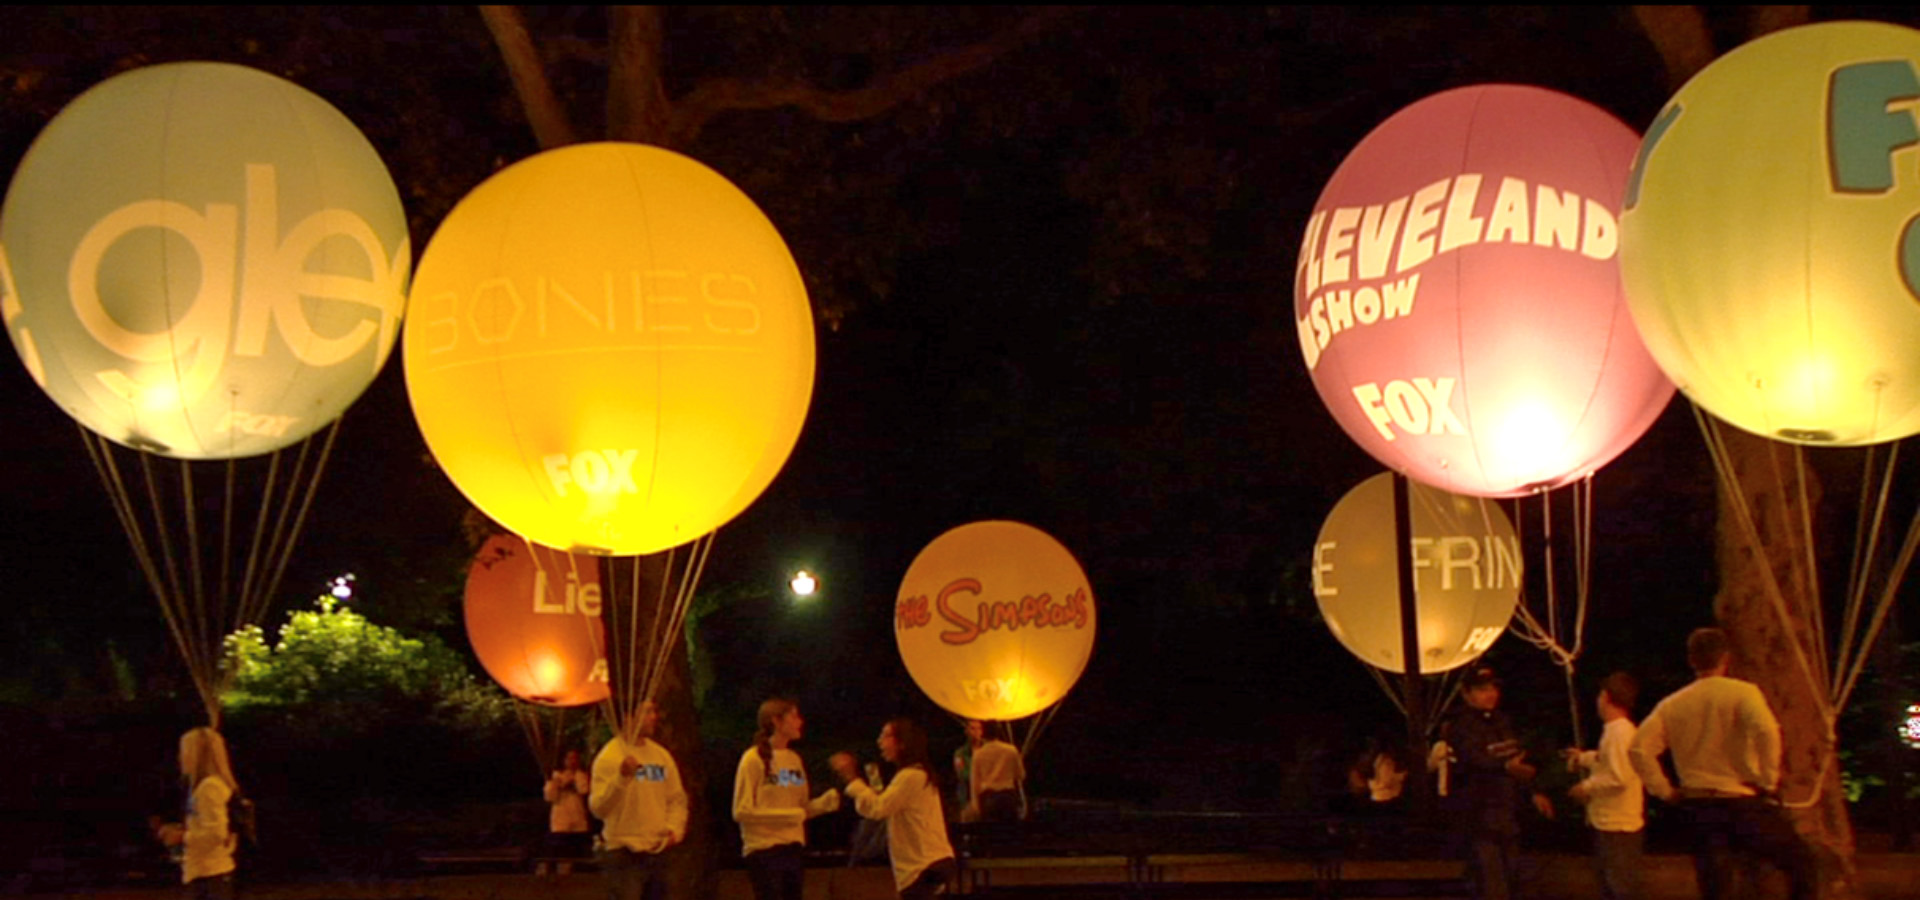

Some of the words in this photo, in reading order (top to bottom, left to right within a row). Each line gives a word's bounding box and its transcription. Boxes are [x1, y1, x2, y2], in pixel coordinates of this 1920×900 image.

[420, 269, 760, 356] BONES
[1311, 273, 1420, 350] SHOW
[213, 410, 301, 438] FOX
[1352, 377, 1466, 441] FOX
[543, 448, 640, 498] FOX
[533, 570, 602, 617] Lie
[961, 677, 1016, 702] FOX
